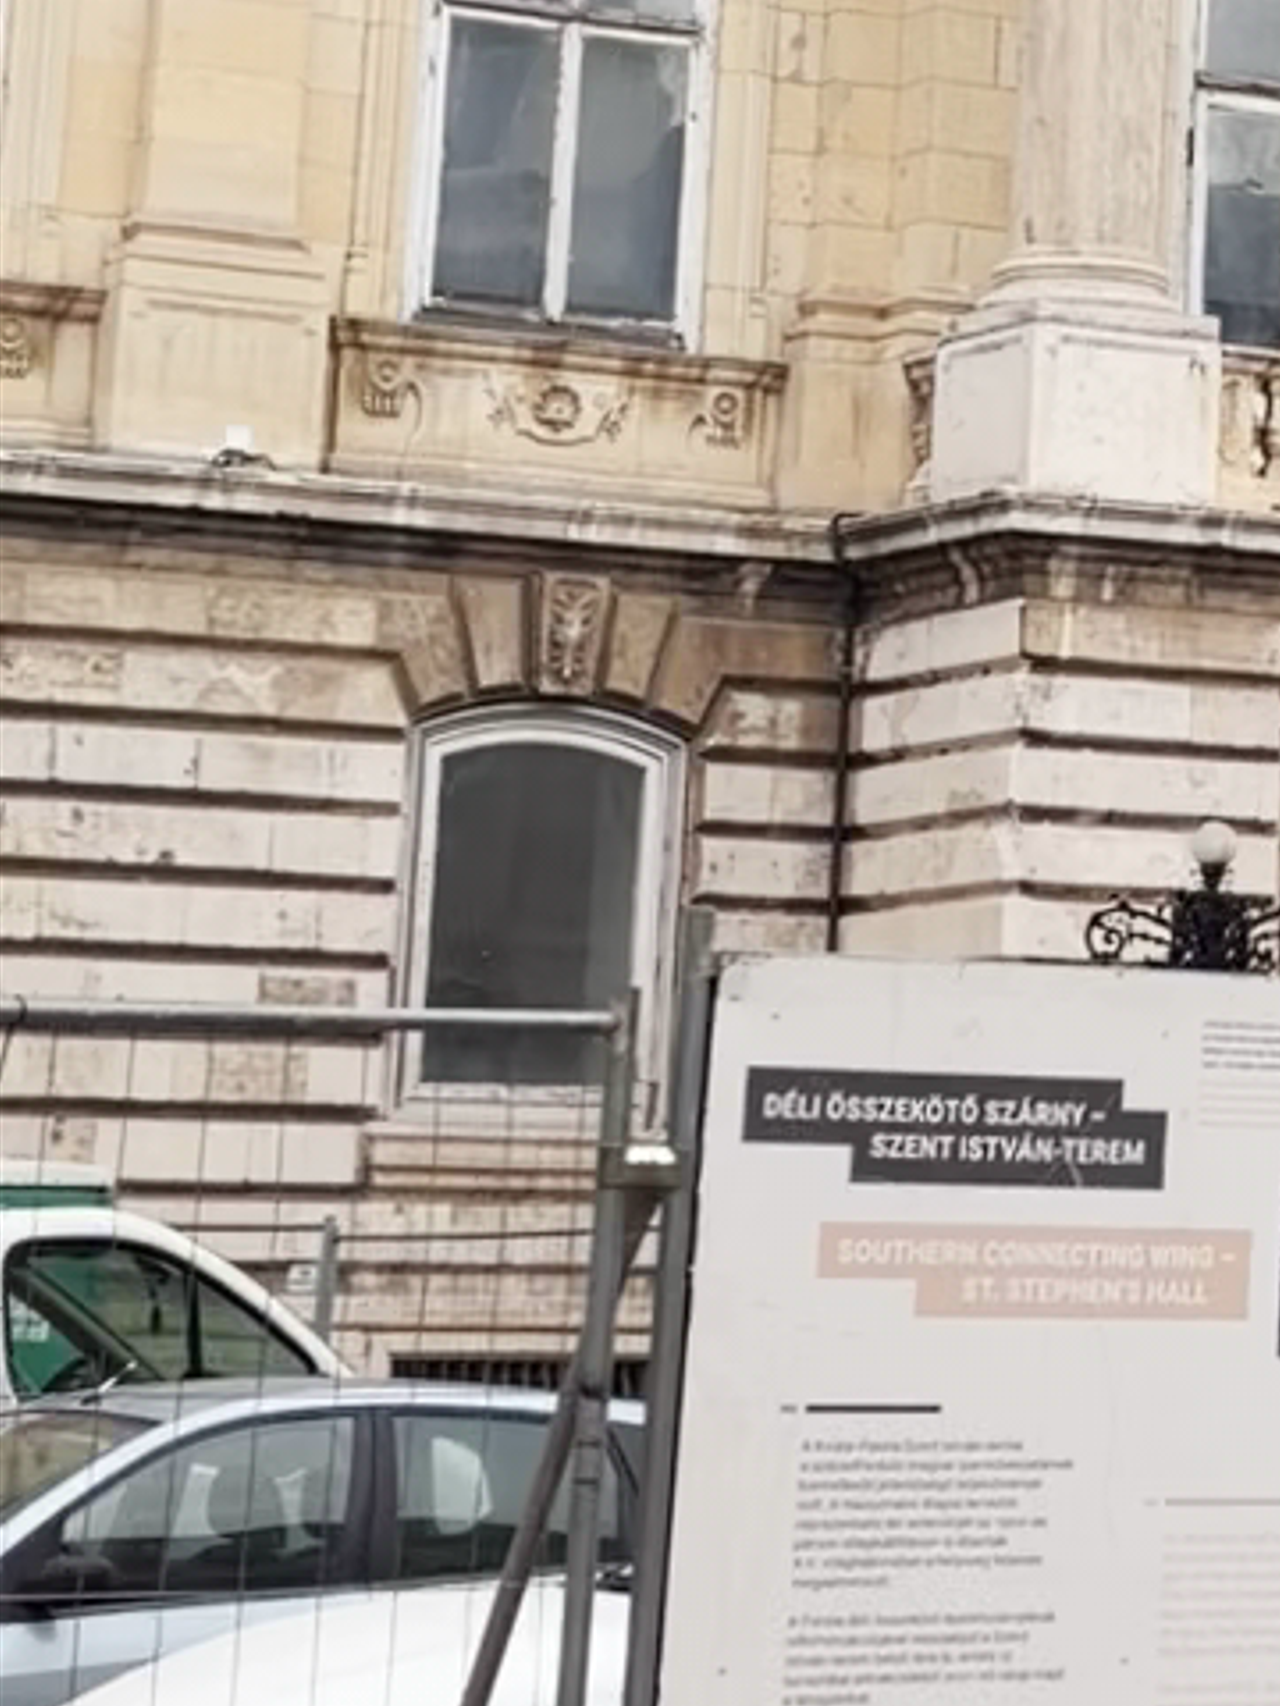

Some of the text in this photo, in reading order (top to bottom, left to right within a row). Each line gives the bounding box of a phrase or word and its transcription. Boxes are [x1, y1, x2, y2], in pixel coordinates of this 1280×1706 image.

[763, 1088, 821, 1120] DÉLI
[984, 1094, 1087, 1129] SZÁRNY
[869, 1131, 1146, 1166] SZENT ISTVÁN-TEREM
[837, 1238, 978, 1267] SOUTHERN
[983, 1241, 1145, 1269] CONNECTING
[1150, 1244, 1216, 1269] WING
[961, 1276, 1000, 1304] ST.
[1145, 1278, 1208, 1305] HALL
